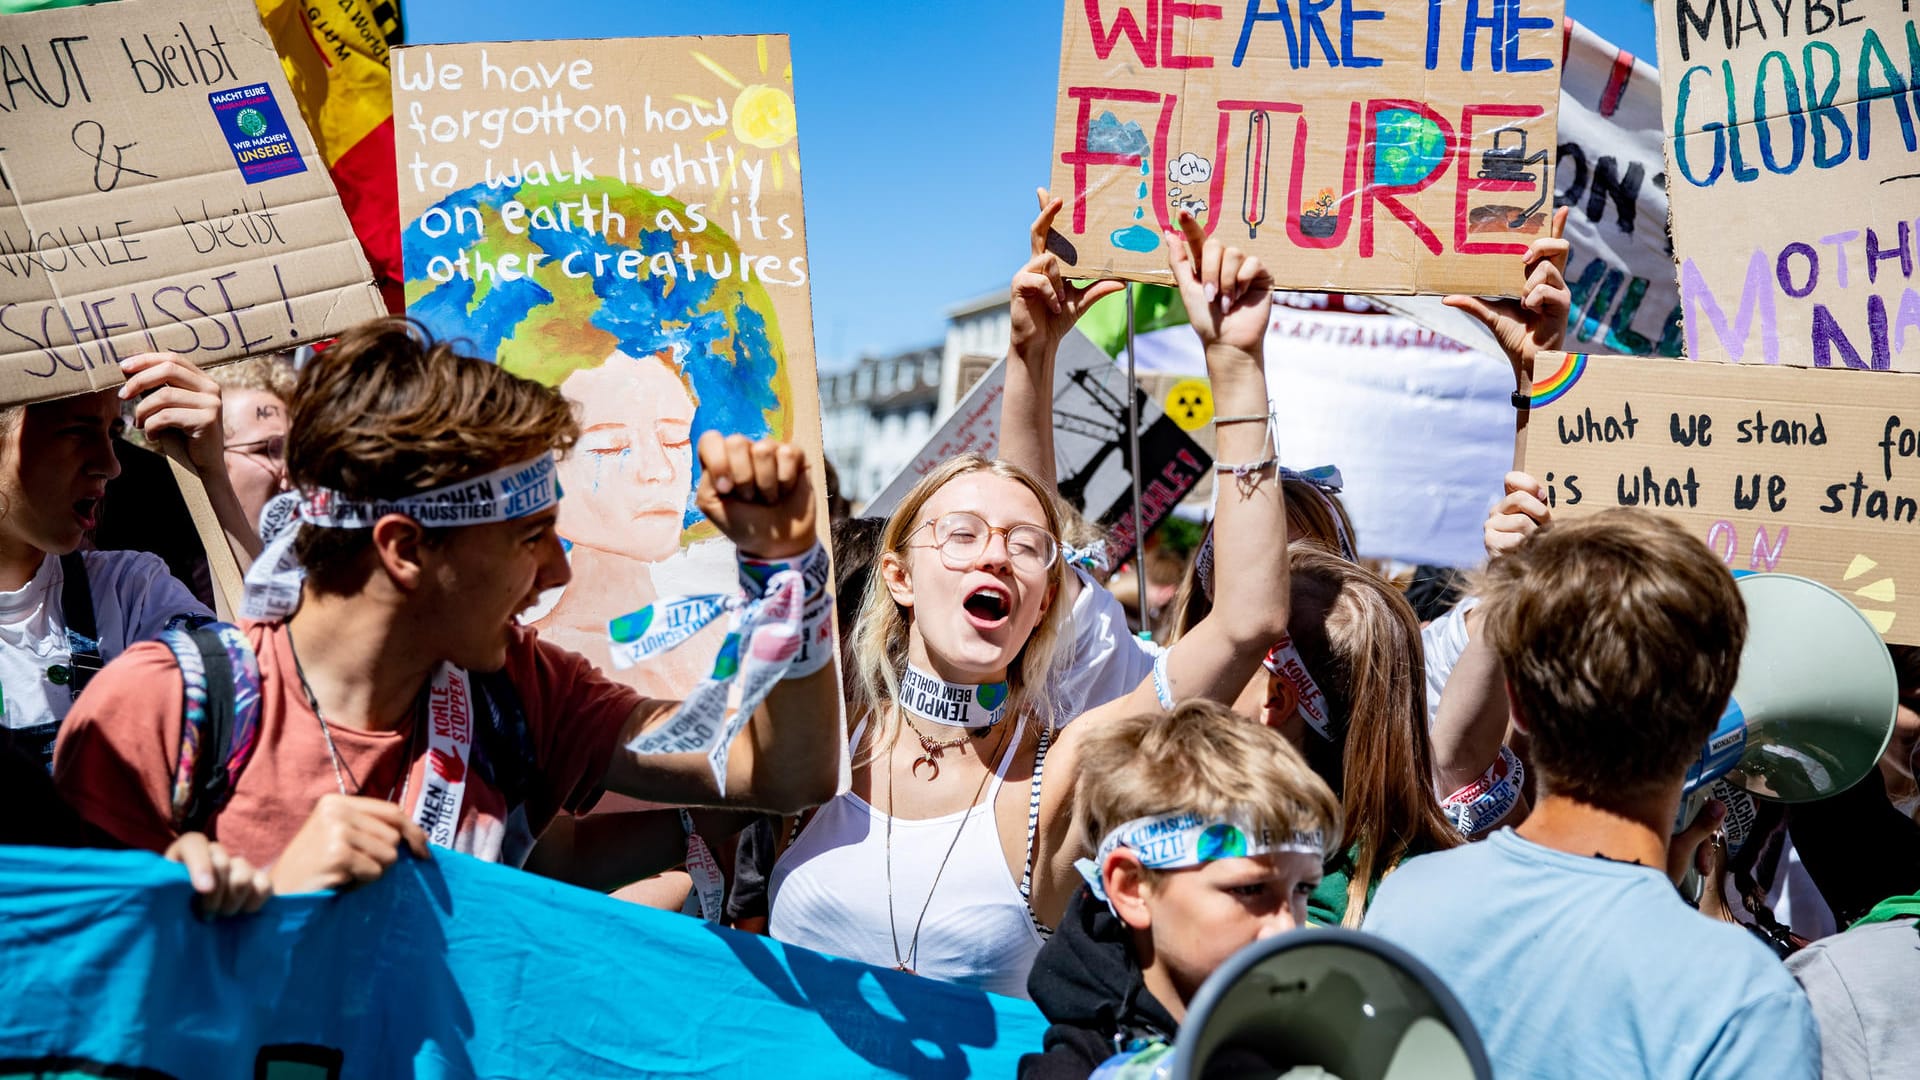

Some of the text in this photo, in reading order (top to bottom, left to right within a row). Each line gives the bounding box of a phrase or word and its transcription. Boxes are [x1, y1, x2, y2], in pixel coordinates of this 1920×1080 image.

[307, 7, 351, 61] GIUM
[1083, 0, 1223, 69] WE
[1232, 0, 1384, 69] ARE
[1677, 0, 1865, 61] MAYBE
[119, 21, 239, 94] bleibt
[397, 48, 594, 93] We have
[211, 91, 243, 104] MACHT
[244, 86, 267, 98] EURE
[234, 132, 287, 150] WIR MACHEN
[409, 93, 730, 149] forgotton how
[238, 141, 293, 163] UNSERE!
[408, 142, 764, 204] to walk lightly
[1061, 87, 1545, 258] FUTURE
[174, 190, 287, 254] bleibt
[419, 193, 794, 240] on earth as its
[426, 241, 807, 287] other creatures
[1558, 401, 1920, 481] what we stand fo
[504, 476, 552, 515] JETZT!
[1546, 466, 1920, 522] is what we stan
[942, 687, 972, 703] BEIM
[1283, 658, 1323, 701] KOHLE
[432, 686, 450, 737] KOHLE
[448, 671, 466, 744] STOPPEN!
[916, 693, 969, 722] TEMPO
[1475, 781, 1510, 817] JETZT!
